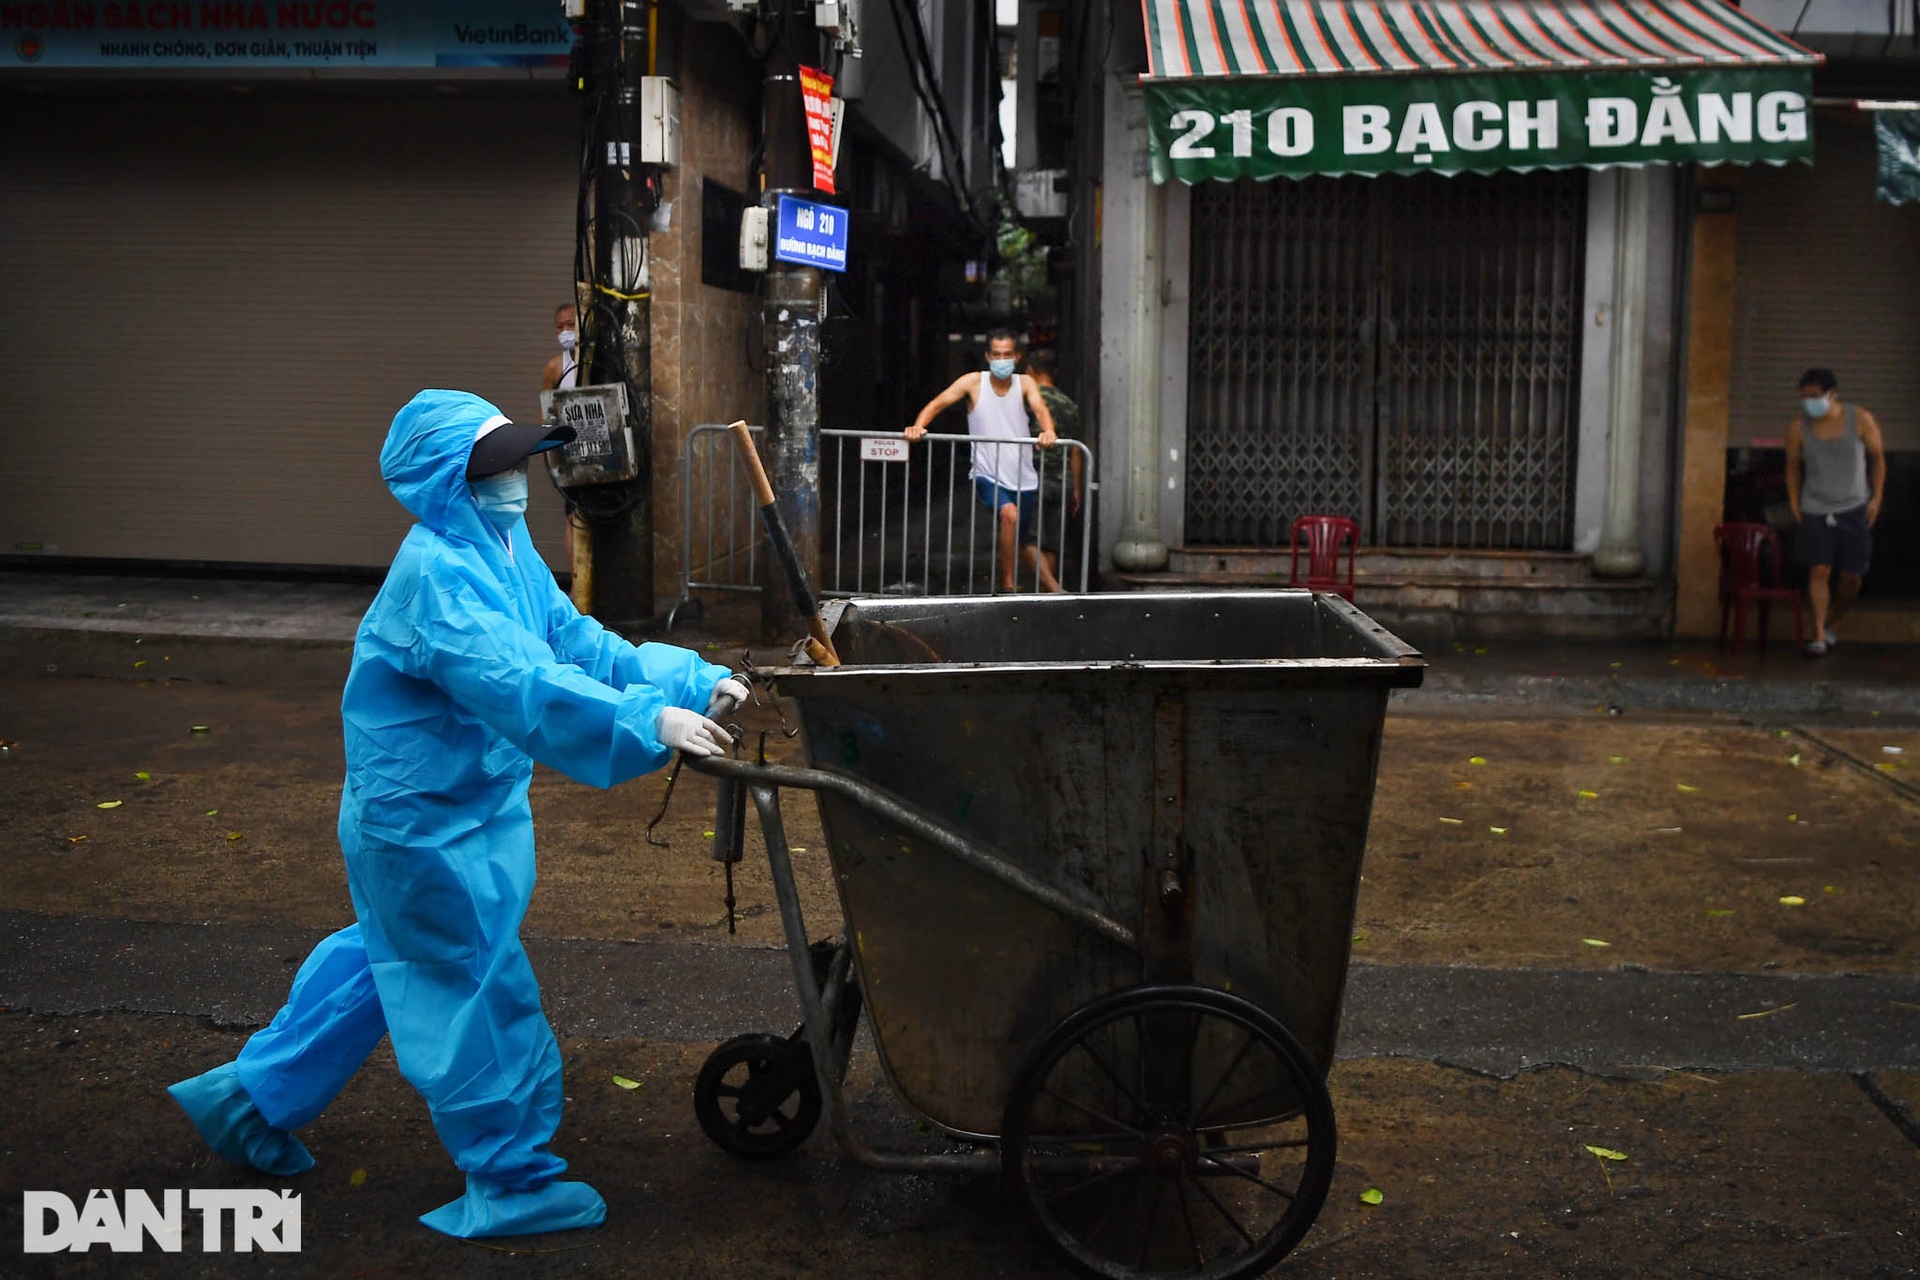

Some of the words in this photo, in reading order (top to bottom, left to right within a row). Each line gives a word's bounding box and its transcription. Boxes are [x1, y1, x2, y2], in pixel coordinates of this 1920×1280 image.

[454, 23, 569, 46] VietinBank
[100, 42, 150, 57] NHANH
[1168, 106, 1315, 160] 210
[1342, 98, 1559, 164] BẠCH
[1585, 76, 1808, 148] ĐẰNG
[819, 212, 835, 236] 210
[870, 447, 899, 456] STOP
